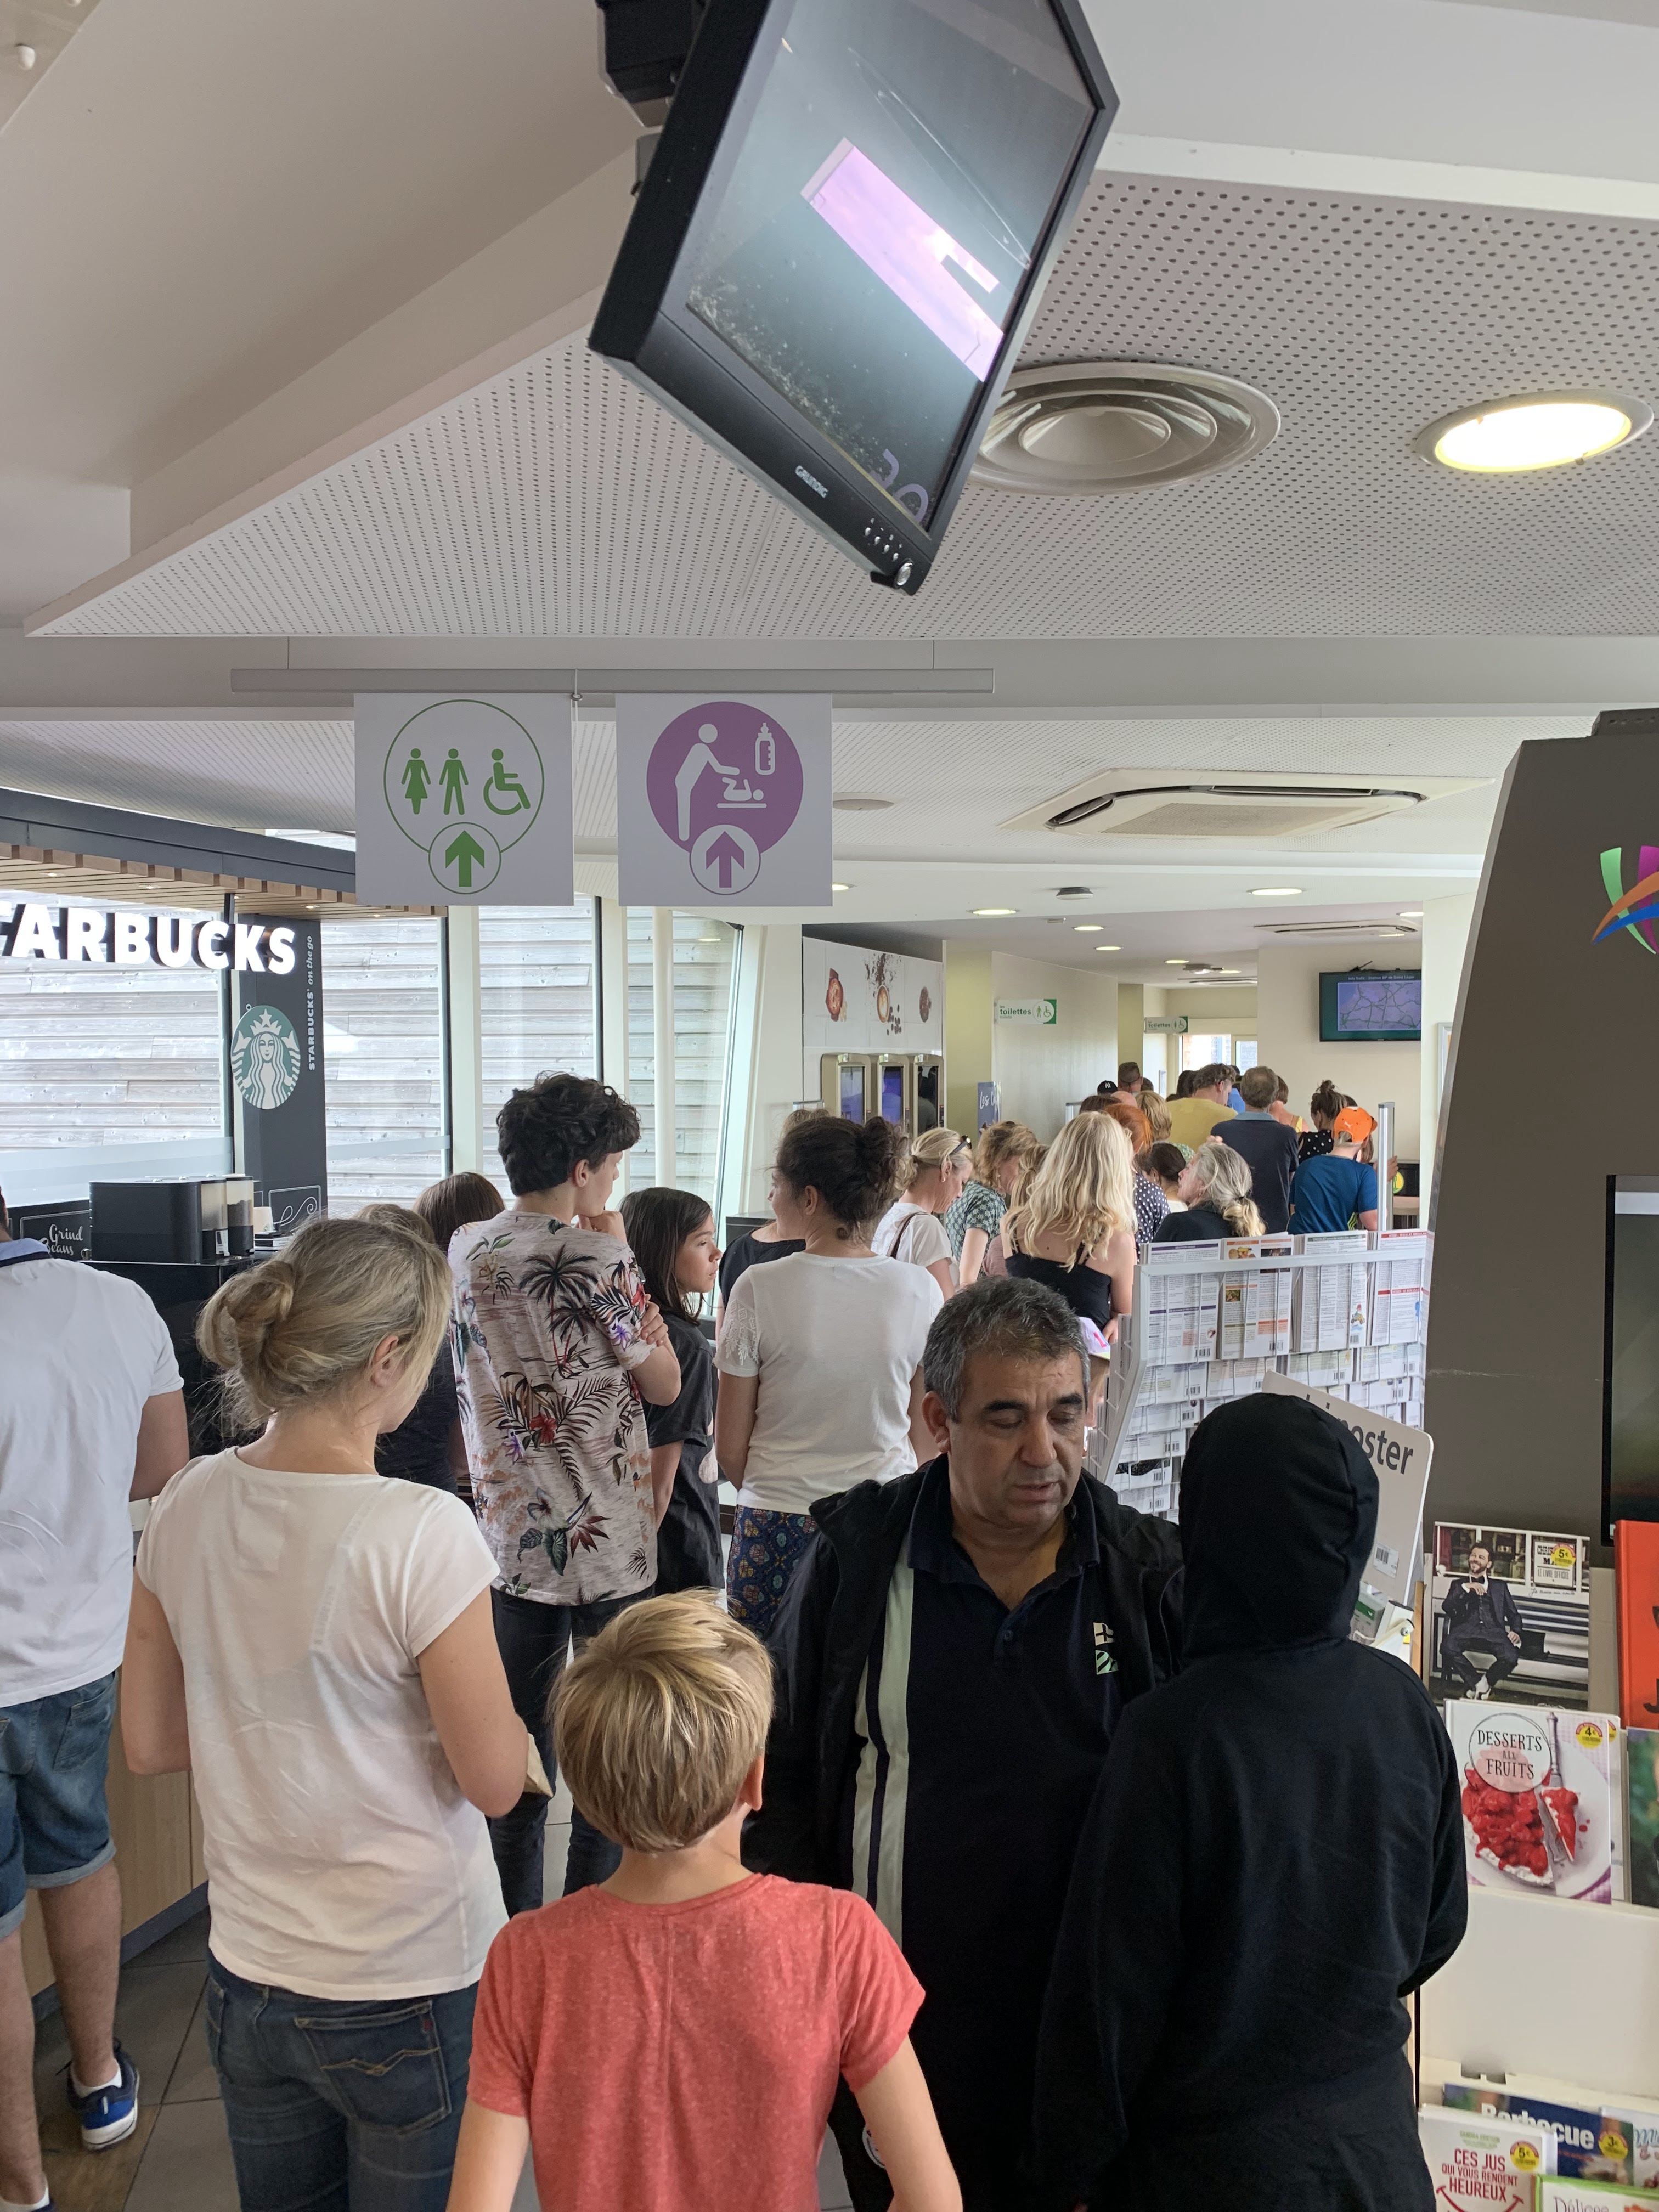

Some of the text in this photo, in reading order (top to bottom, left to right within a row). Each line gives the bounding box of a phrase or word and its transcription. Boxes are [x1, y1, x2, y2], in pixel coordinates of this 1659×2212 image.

[795, 465, 829, 498] GRUNDIG
[0, 901, 295, 974] ARBUCKS
[307, 935, 314, 950] go
[306, 951, 314, 969] the
[308, 970, 314, 985] on
[979, 1091, 990, 1109] Les
[49, 1224, 83, 1245] Grind
[38, 1237, 74, 1256] Beans
[1338, 1418, 1414, 1475] oster
[1537, 1545, 1554, 1556] CHRIS
[1477, 1730, 1542, 1752] DESSERTS
[1503, 1750, 1516, 1760] AUX
[1486, 1758, 1534, 1779] FRUITS
[1454, 2148, 1478, 2168] CES
[1482, 2153, 1505, 2172] JUS
[1442, 2163, 1519, 2187] QUI VOUS RENDENT
[1449, 2176, 1507, 2204] HEUREUX
